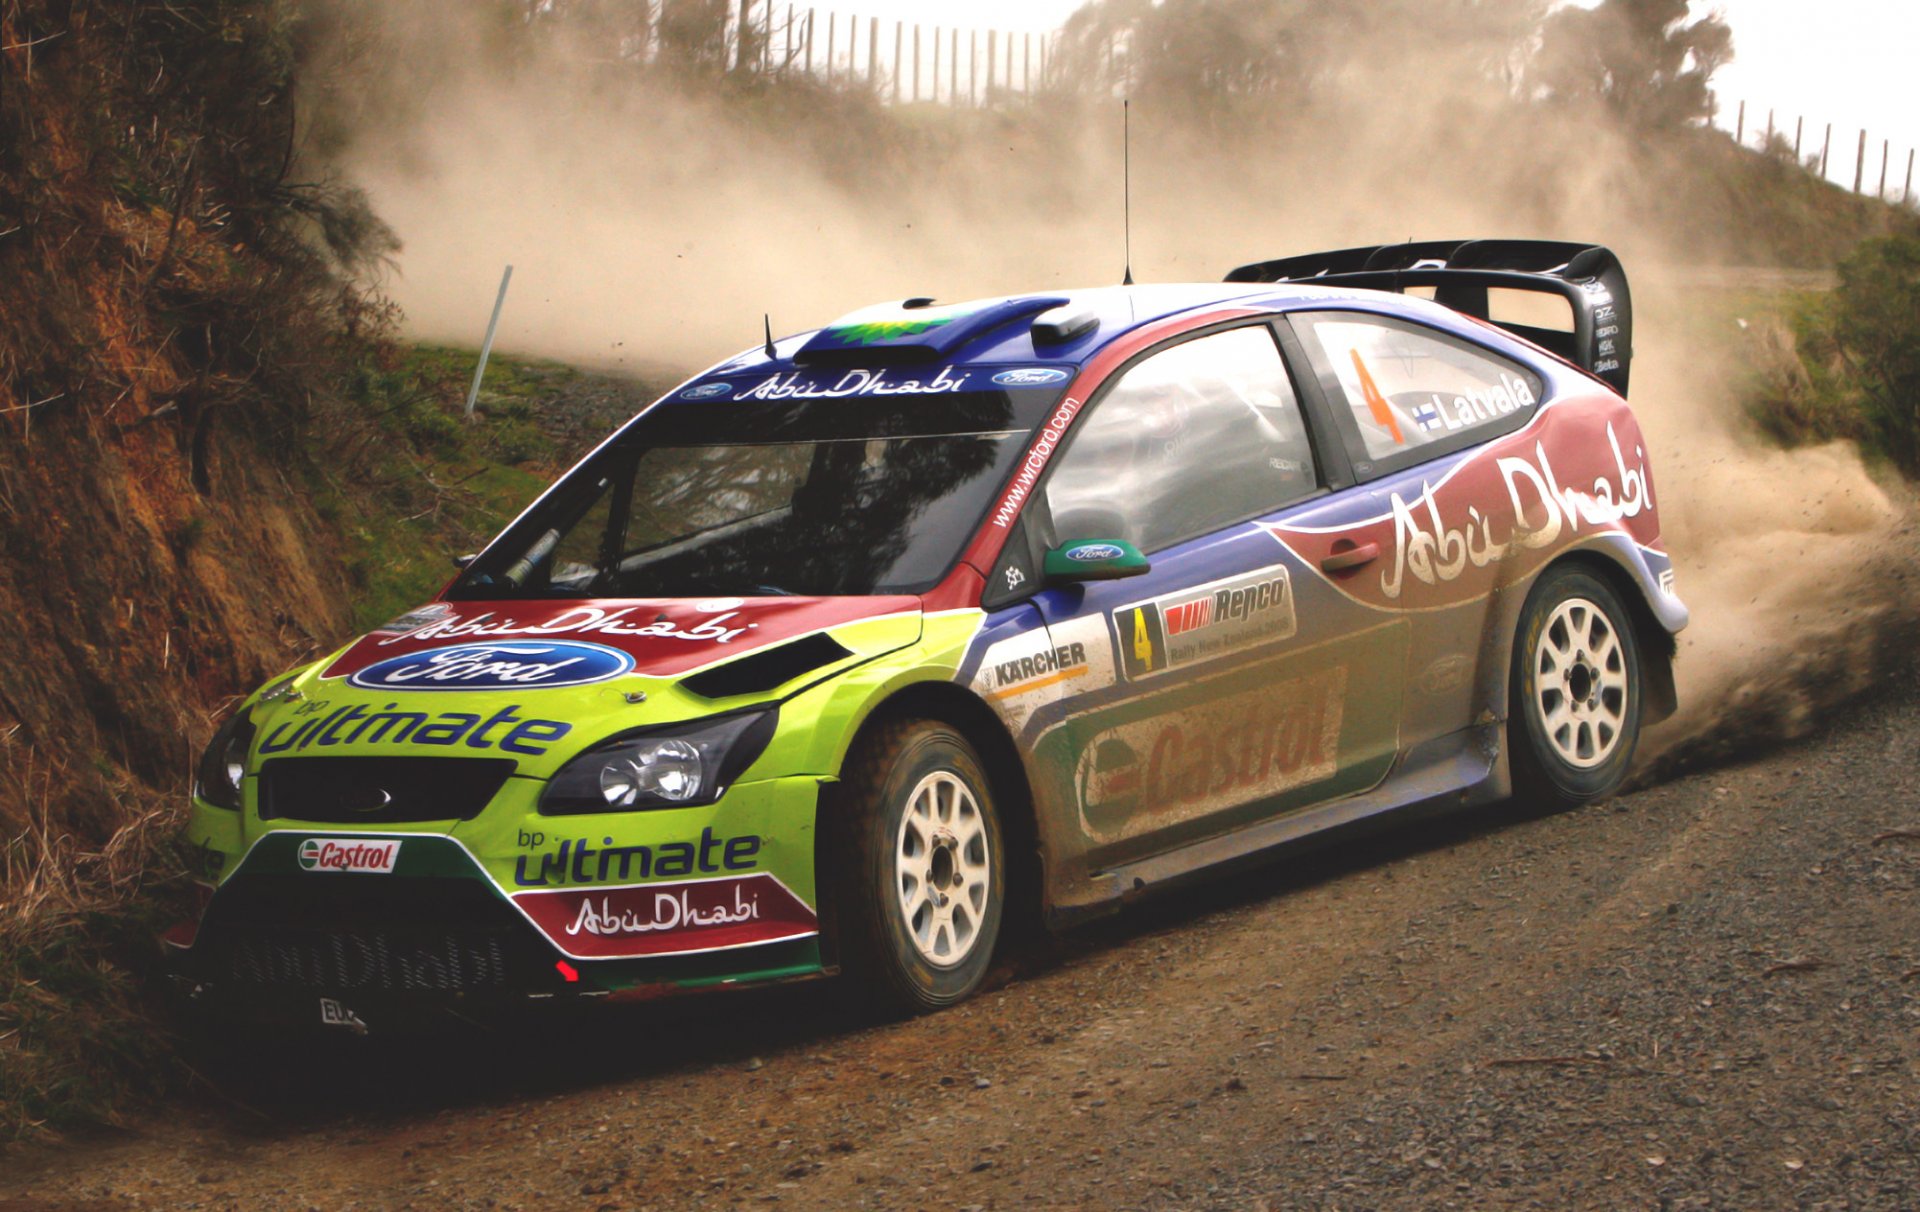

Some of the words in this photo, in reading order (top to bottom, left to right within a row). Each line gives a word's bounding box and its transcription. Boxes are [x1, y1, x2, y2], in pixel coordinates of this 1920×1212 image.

[733, 373, 816, 401] Abu
[825, 366, 971, 396] Dhabi
[1006, 369, 1061, 384] Ford
[1350, 349, 1404, 444] 4
[1431, 373, 1536, 431] Latvala
[993, 397, 1080, 527] www.wrcford.com
[1381, 479, 1505, 598] Abu
[1496, 420, 1654, 548] Dhabi
[1076, 546, 1114, 559] Ford
[1214, 577, 1285, 624] Repco
[378, 612, 520, 645] Abu
[535, 608, 759, 643] Dhabi
[1134, 607, 1153, 671] 4
[385, 648, 587, 684] Ford
[995, 642, 1086, 686] KÄRCHER
[258, 702, 573, 755] ultimate
[1147, 695, 1328, 810] Castrol
[320, 842, 393, 869] Castrol
[515, 826, 761, 886] ultimate
[518, 829, 545, 850] bp
[565, 897, 652, 935] Abu
[655, 884, 760, 930] Dhabi
